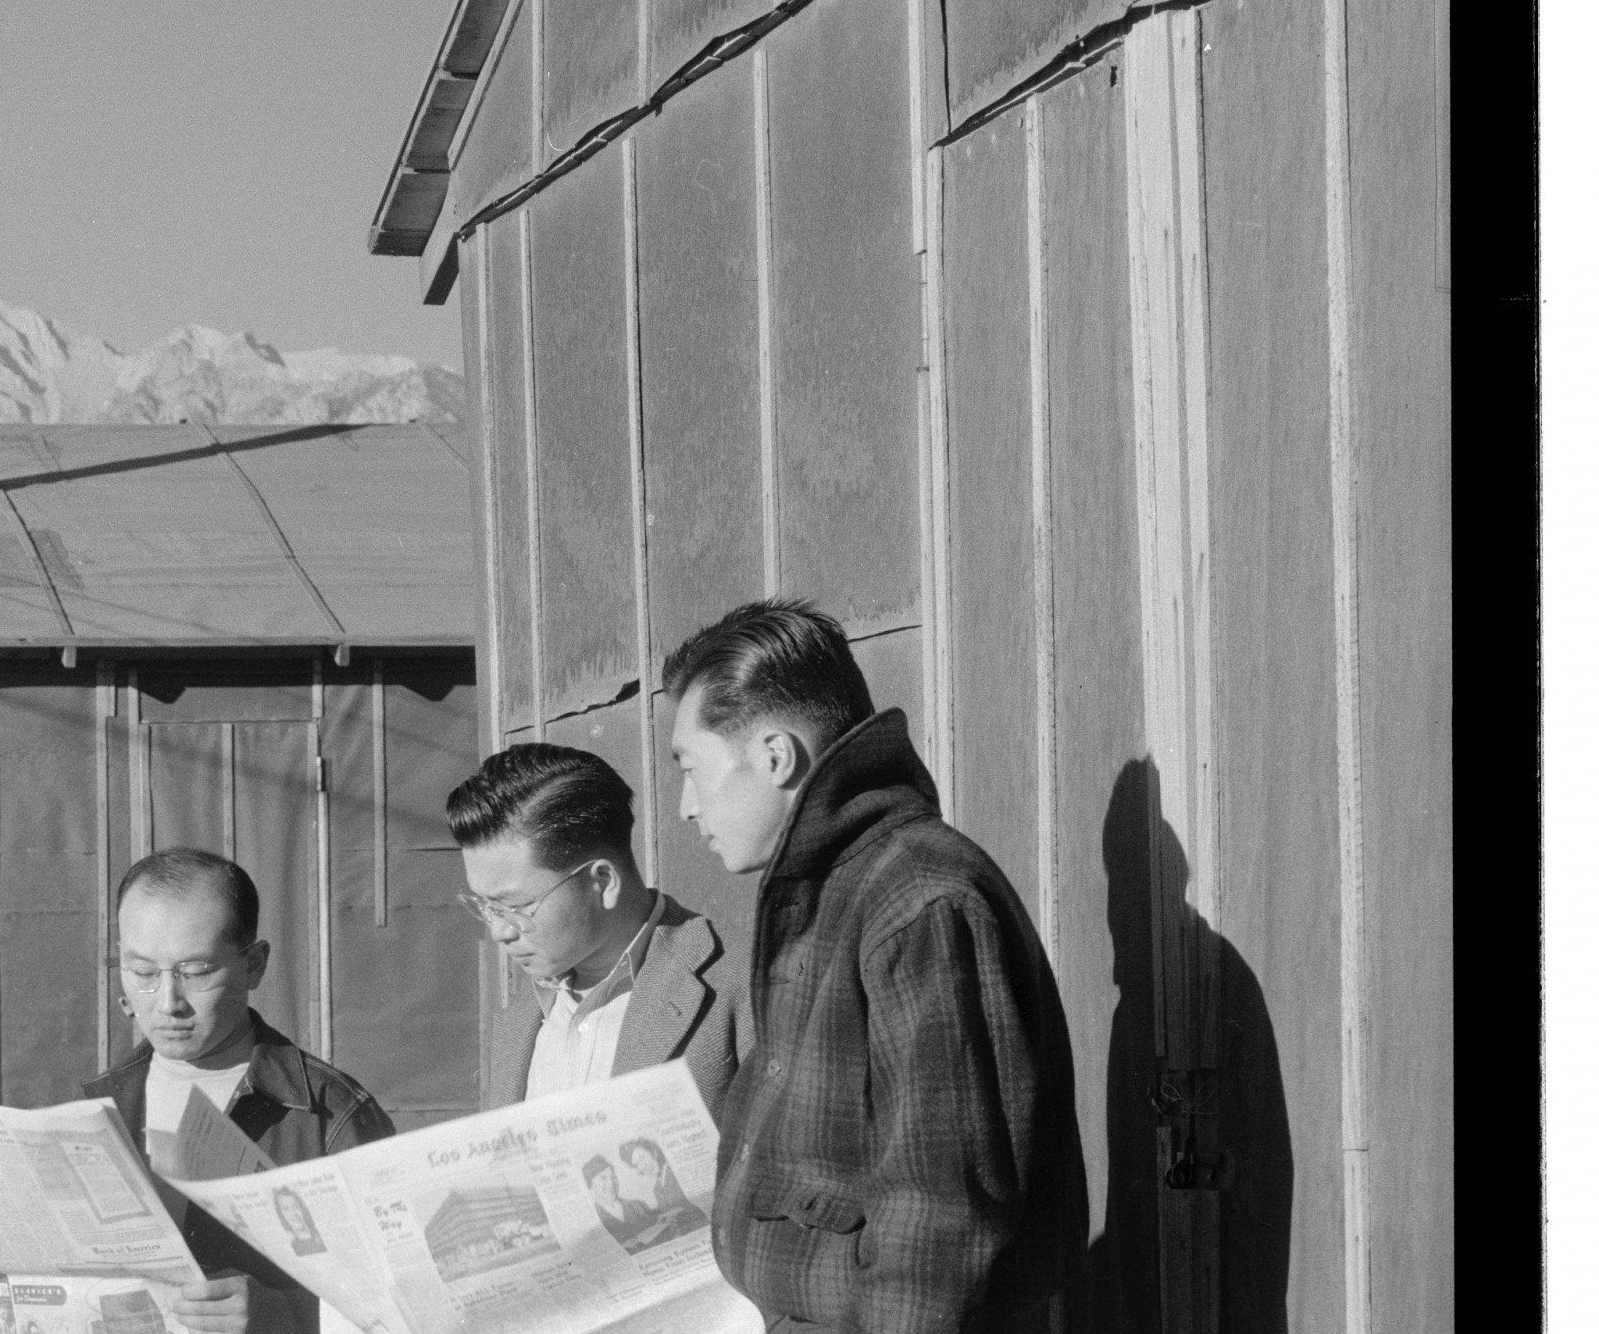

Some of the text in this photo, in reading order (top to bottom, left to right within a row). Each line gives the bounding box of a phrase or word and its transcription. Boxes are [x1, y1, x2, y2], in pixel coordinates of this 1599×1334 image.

[427, 1110, 607, 1168] Los Angeles Times
